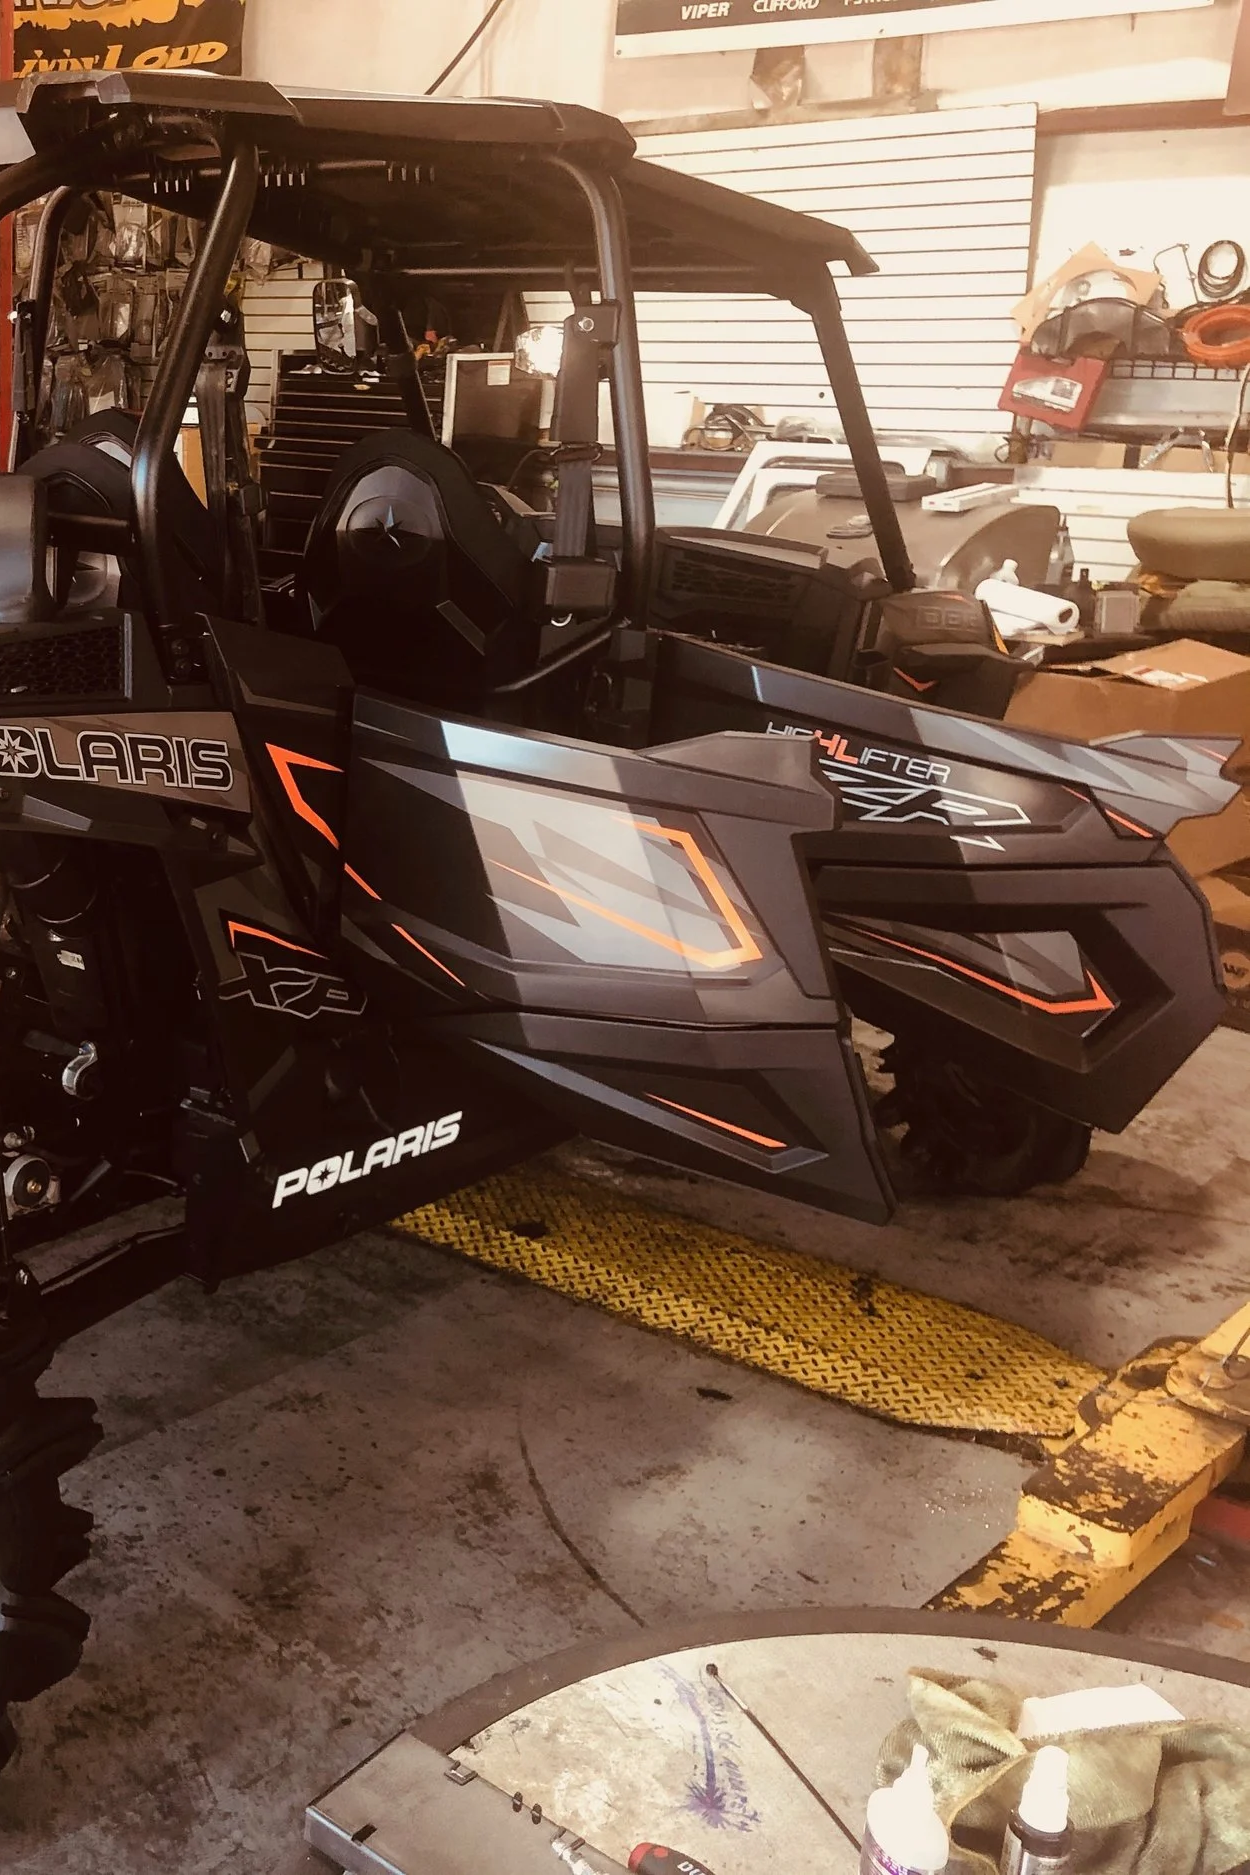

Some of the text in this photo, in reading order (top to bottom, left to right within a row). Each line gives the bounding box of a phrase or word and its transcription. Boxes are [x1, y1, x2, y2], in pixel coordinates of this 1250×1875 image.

[681, 0, 820, 20] VIPER CLIFFORD
[272, 1111, 463, 1209] POLARIS
